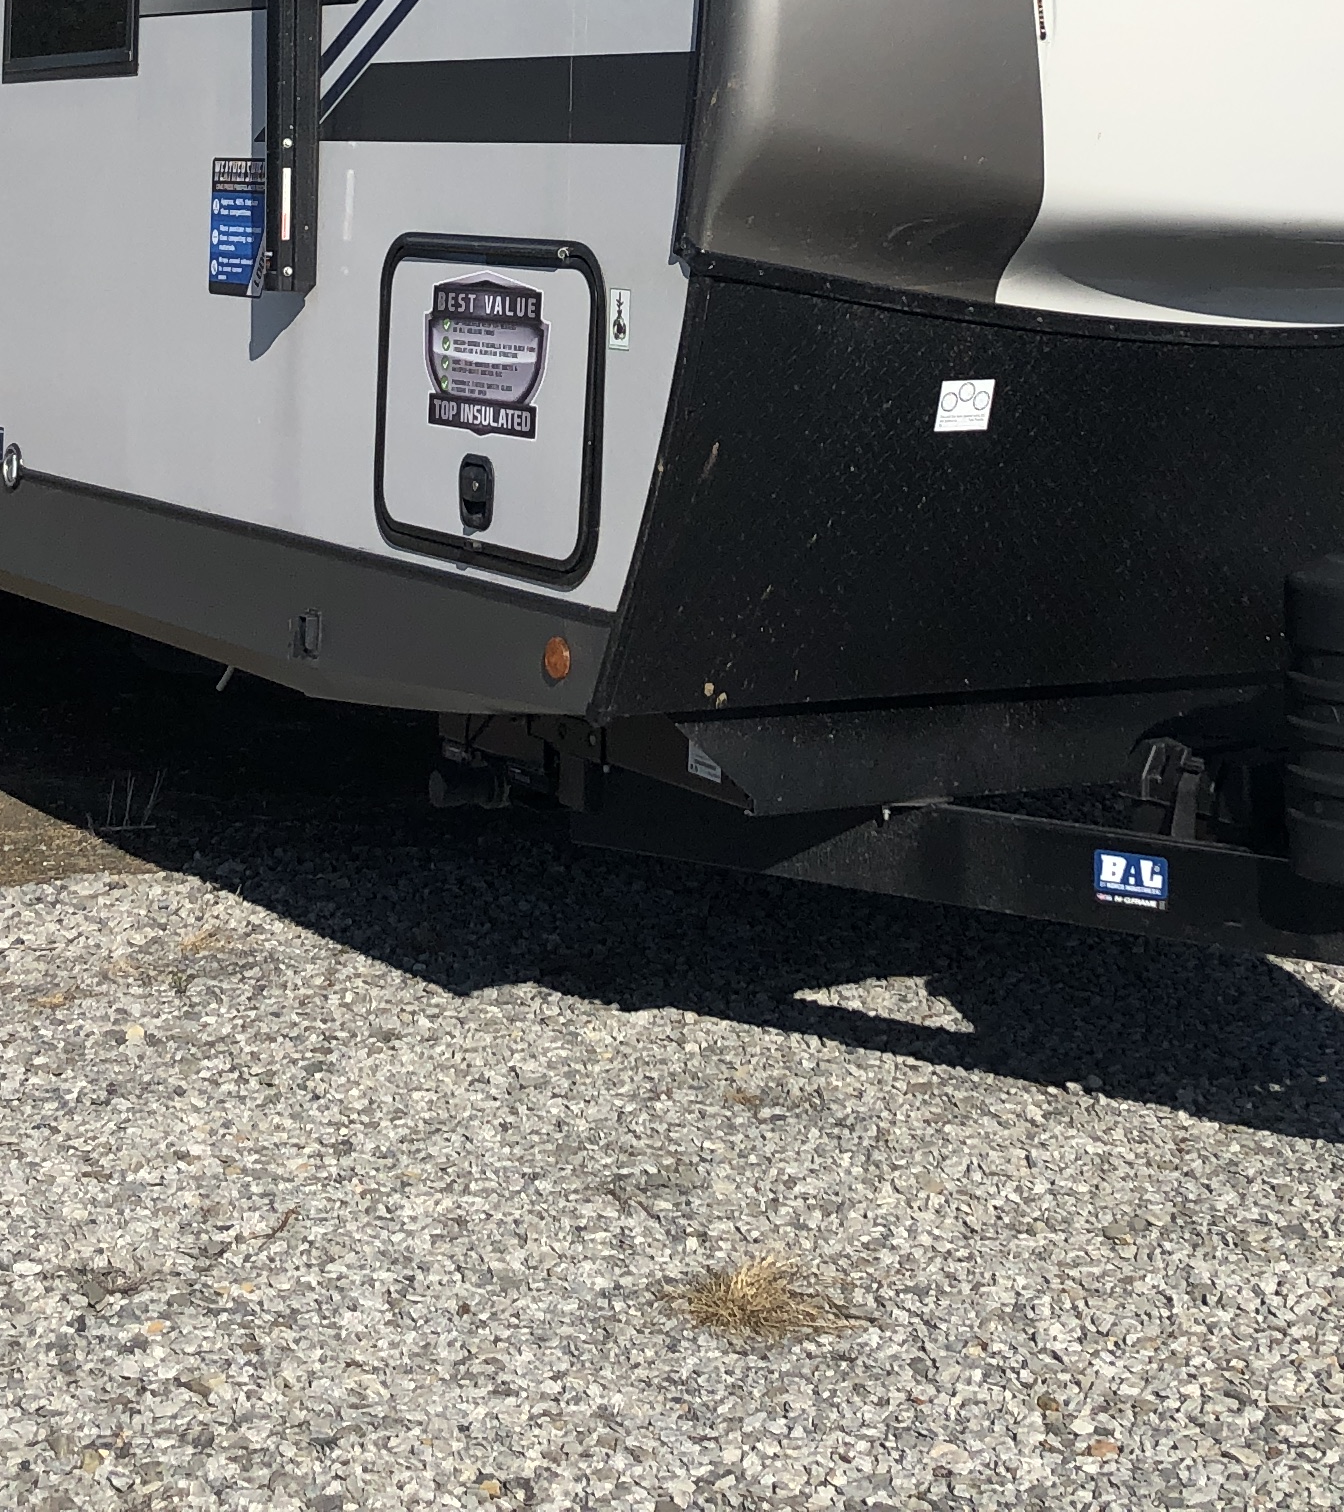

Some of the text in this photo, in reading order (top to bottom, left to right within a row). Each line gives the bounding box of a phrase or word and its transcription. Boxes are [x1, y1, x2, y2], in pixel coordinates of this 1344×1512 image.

[437, 291, 536, 317] BEST VALUE
[434, 399, 531, 431] TOP INSULATED
[1100, 854, 1163, 889] BAL
